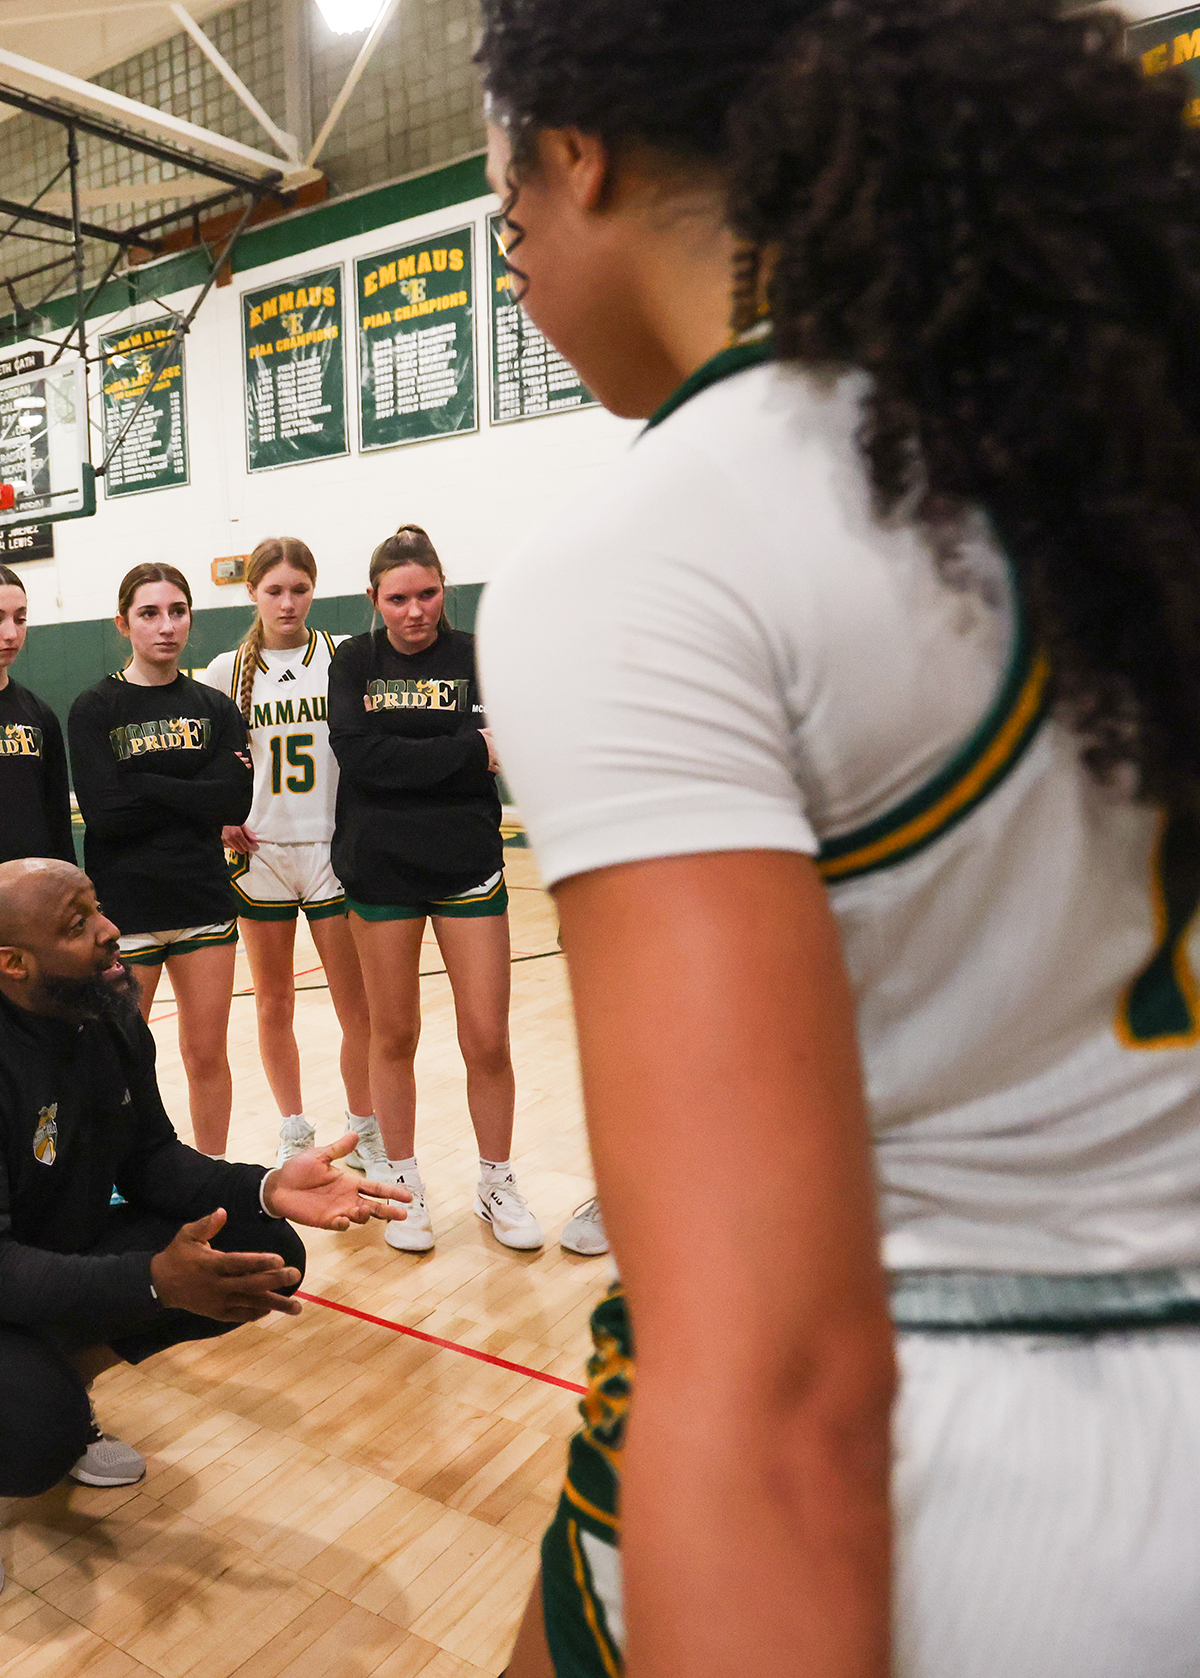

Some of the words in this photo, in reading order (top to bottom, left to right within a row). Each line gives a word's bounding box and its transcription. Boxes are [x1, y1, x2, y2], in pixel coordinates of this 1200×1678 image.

[364, 248, 464, 297] EMMAUS
[249, 286, 336, 329] EMMAUS
[363, 311, 392, 330] PIAA
[394, 290, 468, 322] CHAMPIONS
[275, 325, 338, 352] CHAMPIONS
[14, 355, 35, 371] CATH
[9, 534, 33, 549] LEWIS
[269, 732, 316, 796] 15
